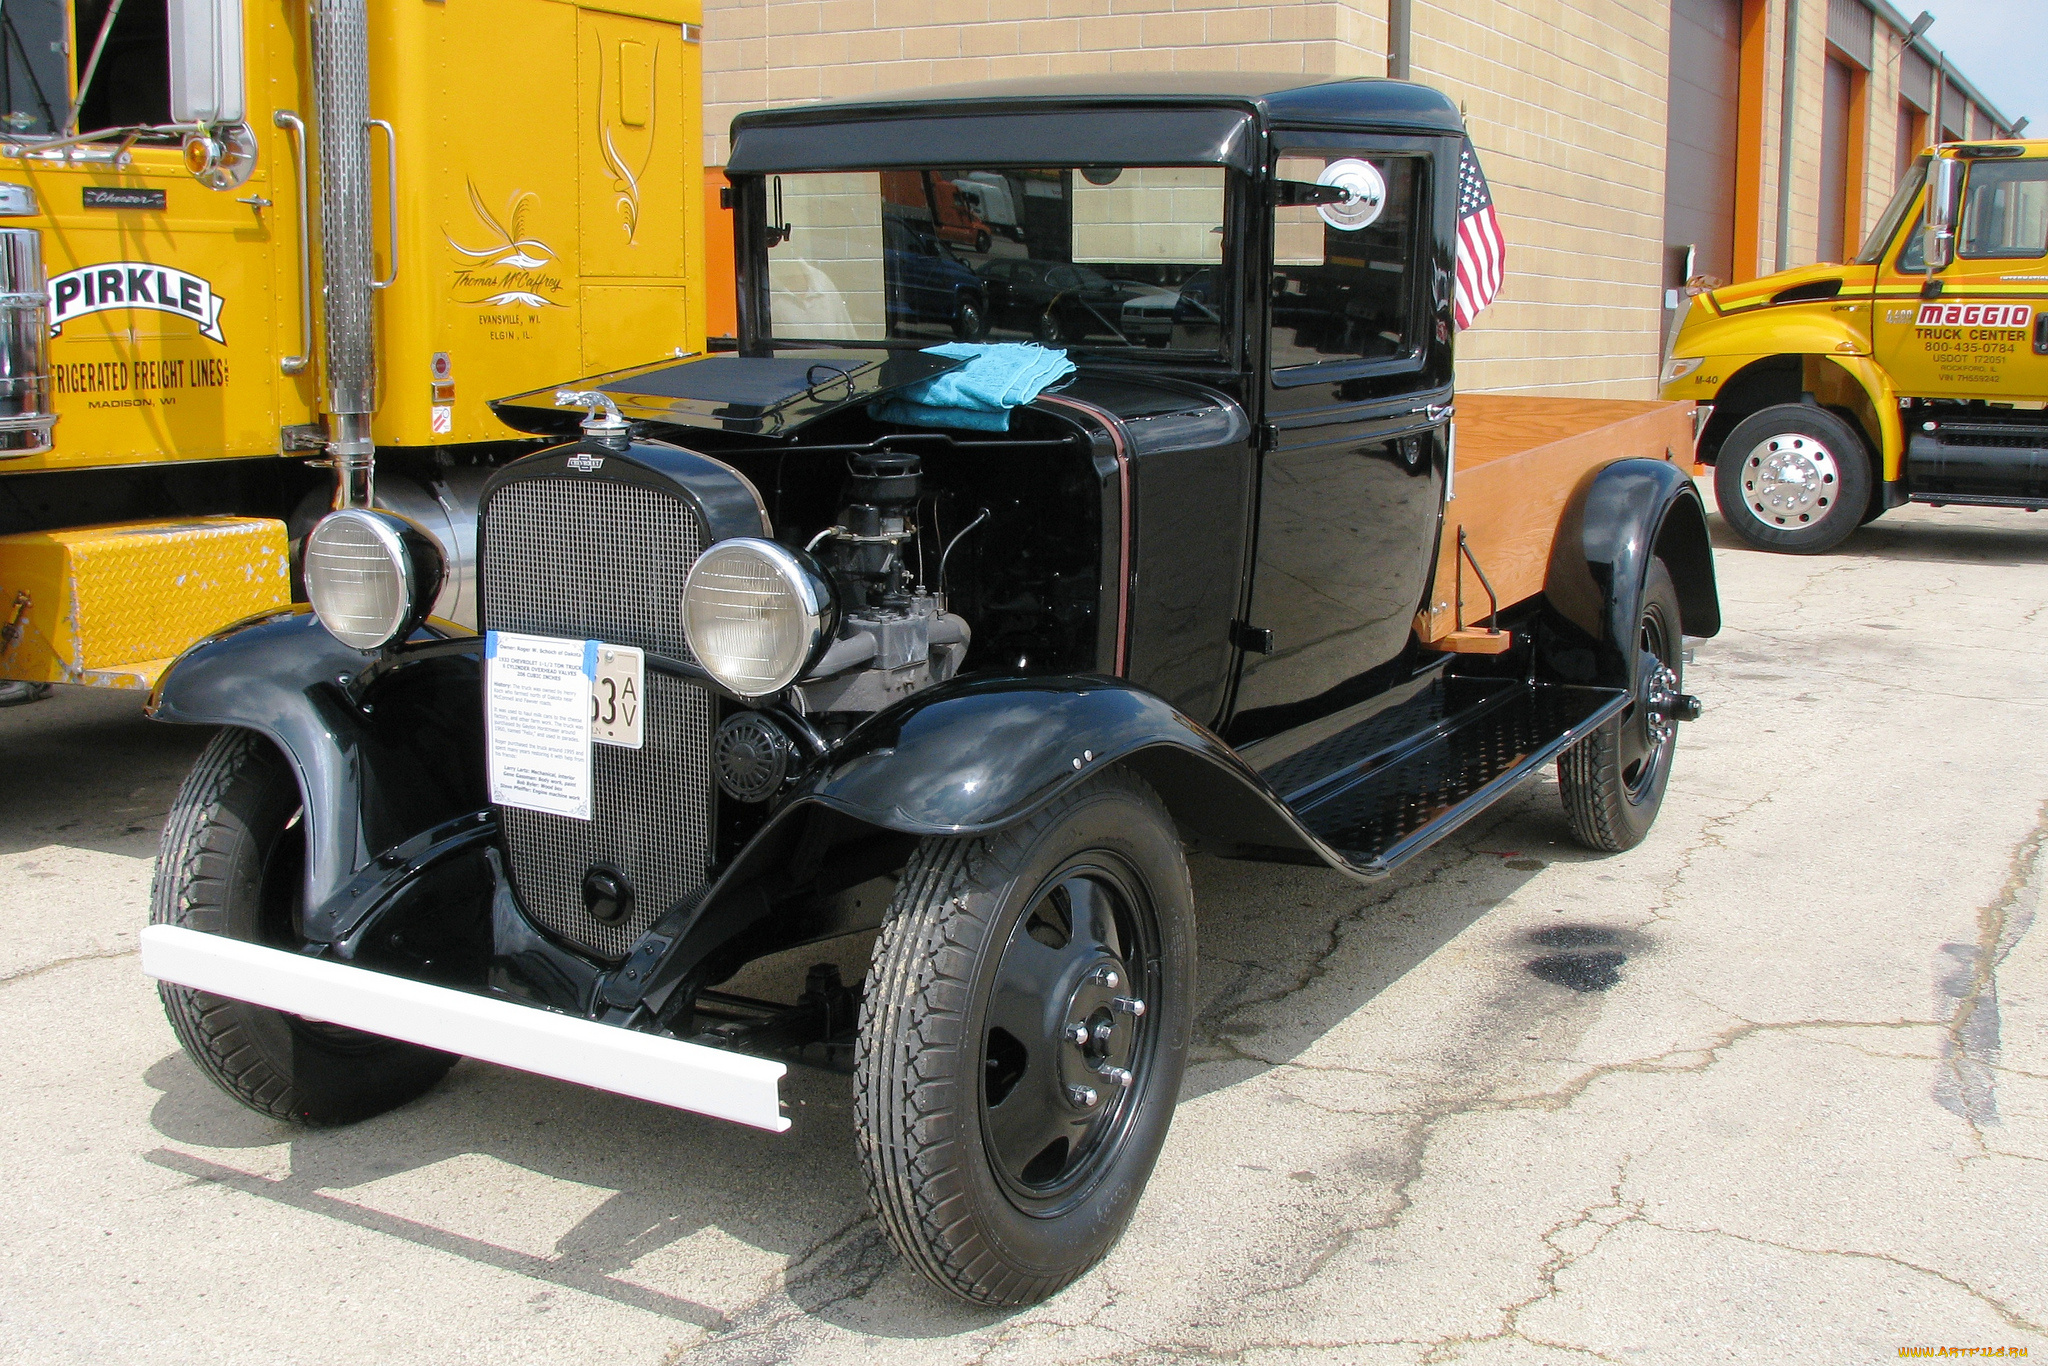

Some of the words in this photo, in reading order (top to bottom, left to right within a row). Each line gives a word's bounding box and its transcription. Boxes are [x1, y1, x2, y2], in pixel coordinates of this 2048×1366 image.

[452, 270, 498, 290] Thomas
[498, 271, 563, 293] McCaffrey
[56, 269, 203, 316] PIRKLE
[479, 315, 523, 326] EVANSVILLE,
[1916, 329, 1961, 340] TRUCK
[1970, 330, 2026, 341] CENTER
[1925, 342, 2014, 353] 800-435-0784
[1933, 354, 1968, 363] USDOT
[1974, 356, 2006, 364] 172051
[52, 362, 127, 393] RIGERATED
[135, 360, 184, 389] FREIGHT
[190, 359, 223, 387] LINES
[89, 400, 154, 408] MADISON,
